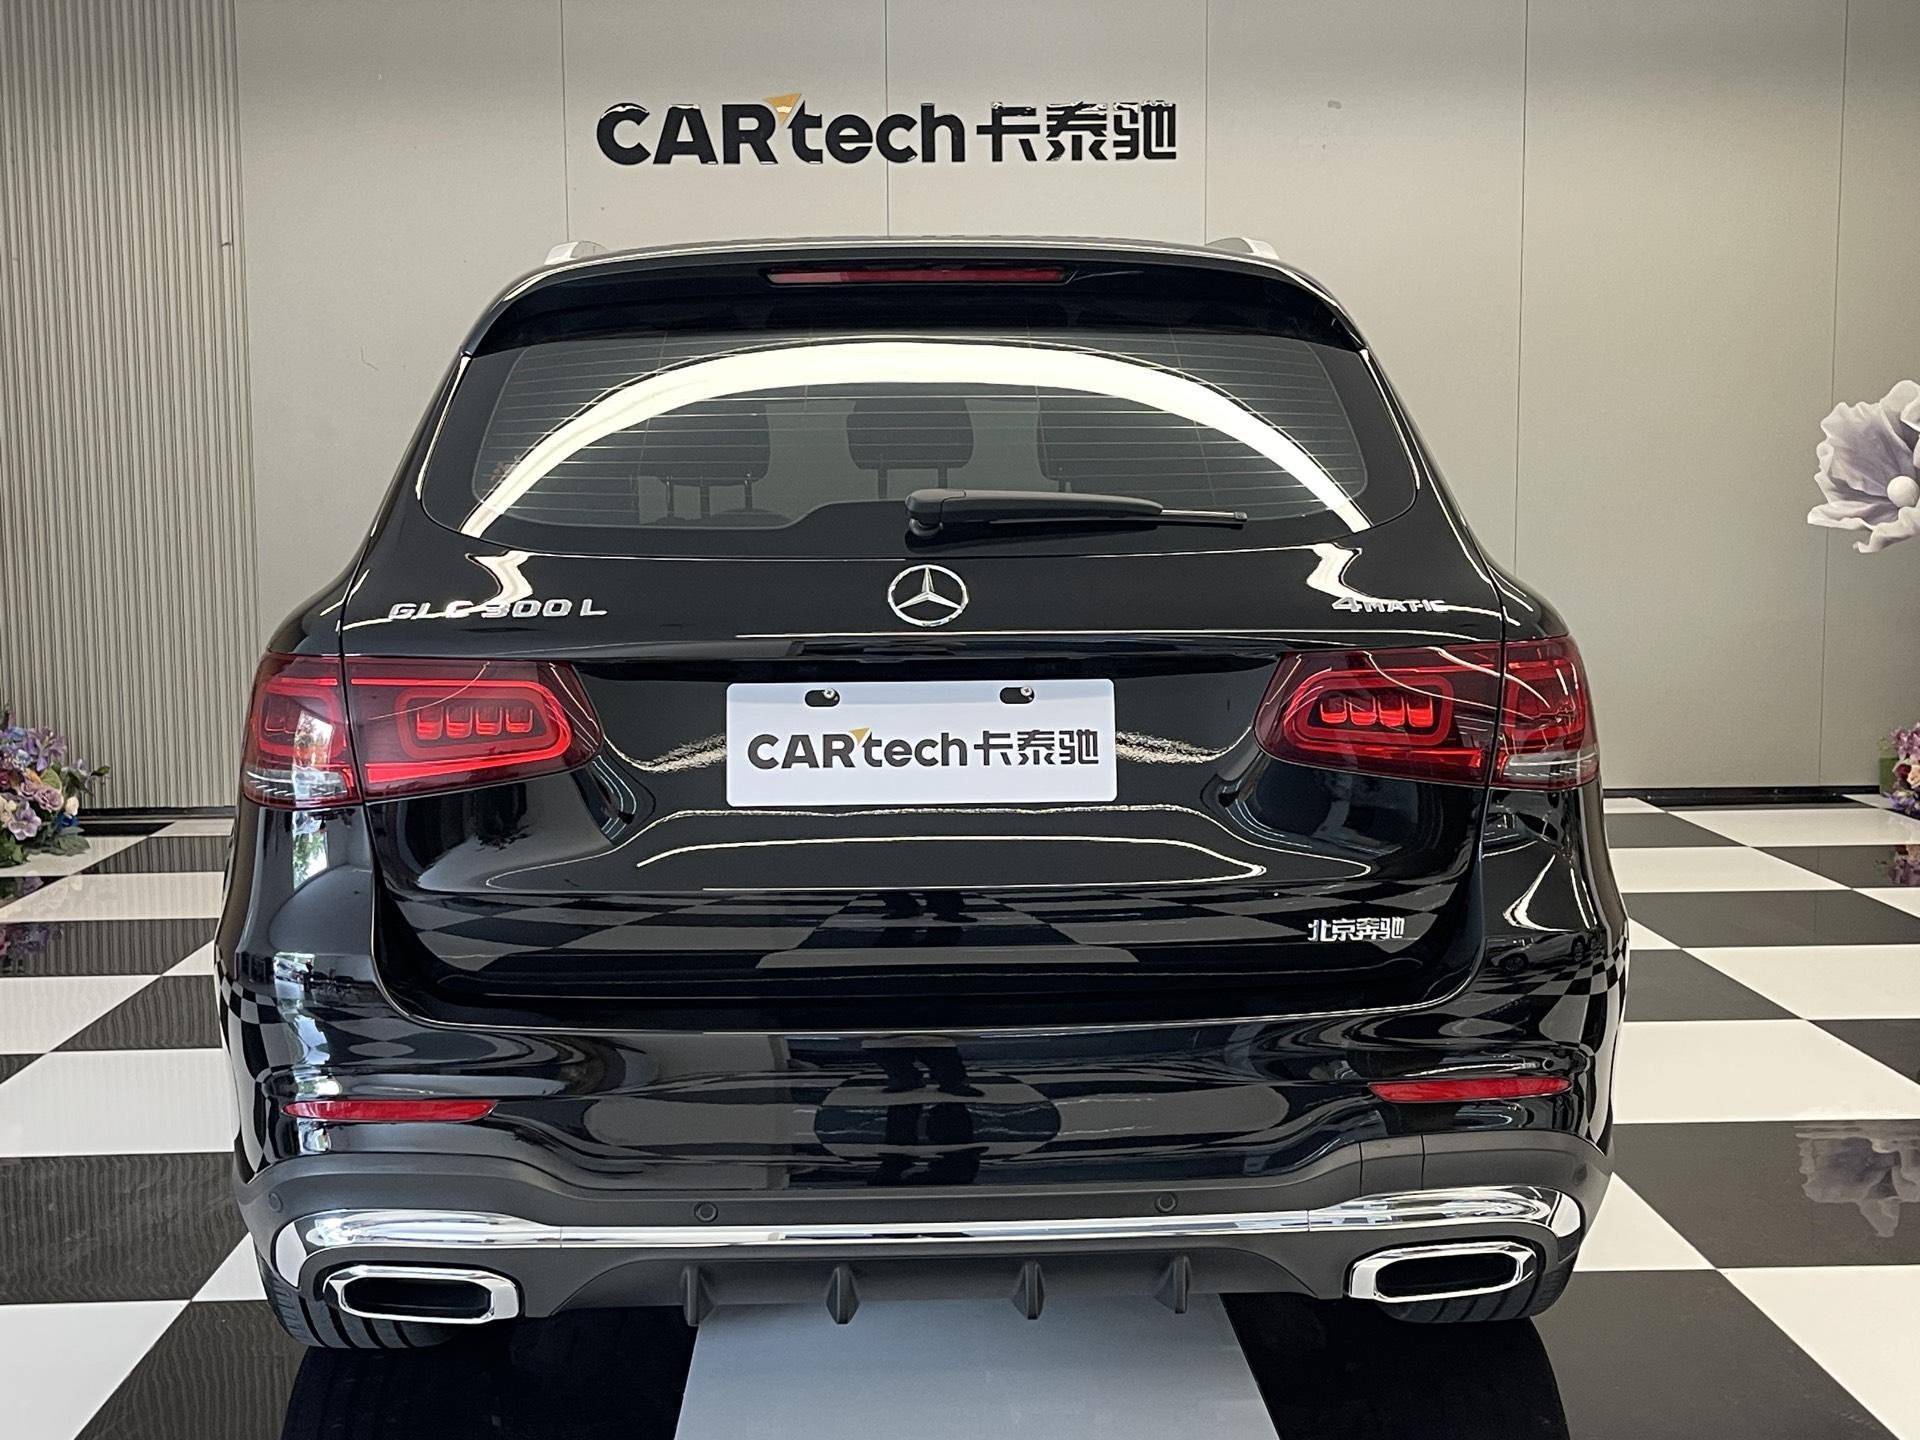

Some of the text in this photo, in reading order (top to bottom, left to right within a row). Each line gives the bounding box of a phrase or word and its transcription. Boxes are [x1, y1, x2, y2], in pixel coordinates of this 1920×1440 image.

[596, 99, 1177, 166] CARtech 卡泰驰
[388, 598, 608, 620] GLC 300 L
[1331, 596, 1450, 613] 4MATIC
[747, 729, 1100, 770] CARtech 卡泰驰
[1307, 916, 1405, 942] 北京奔驰
